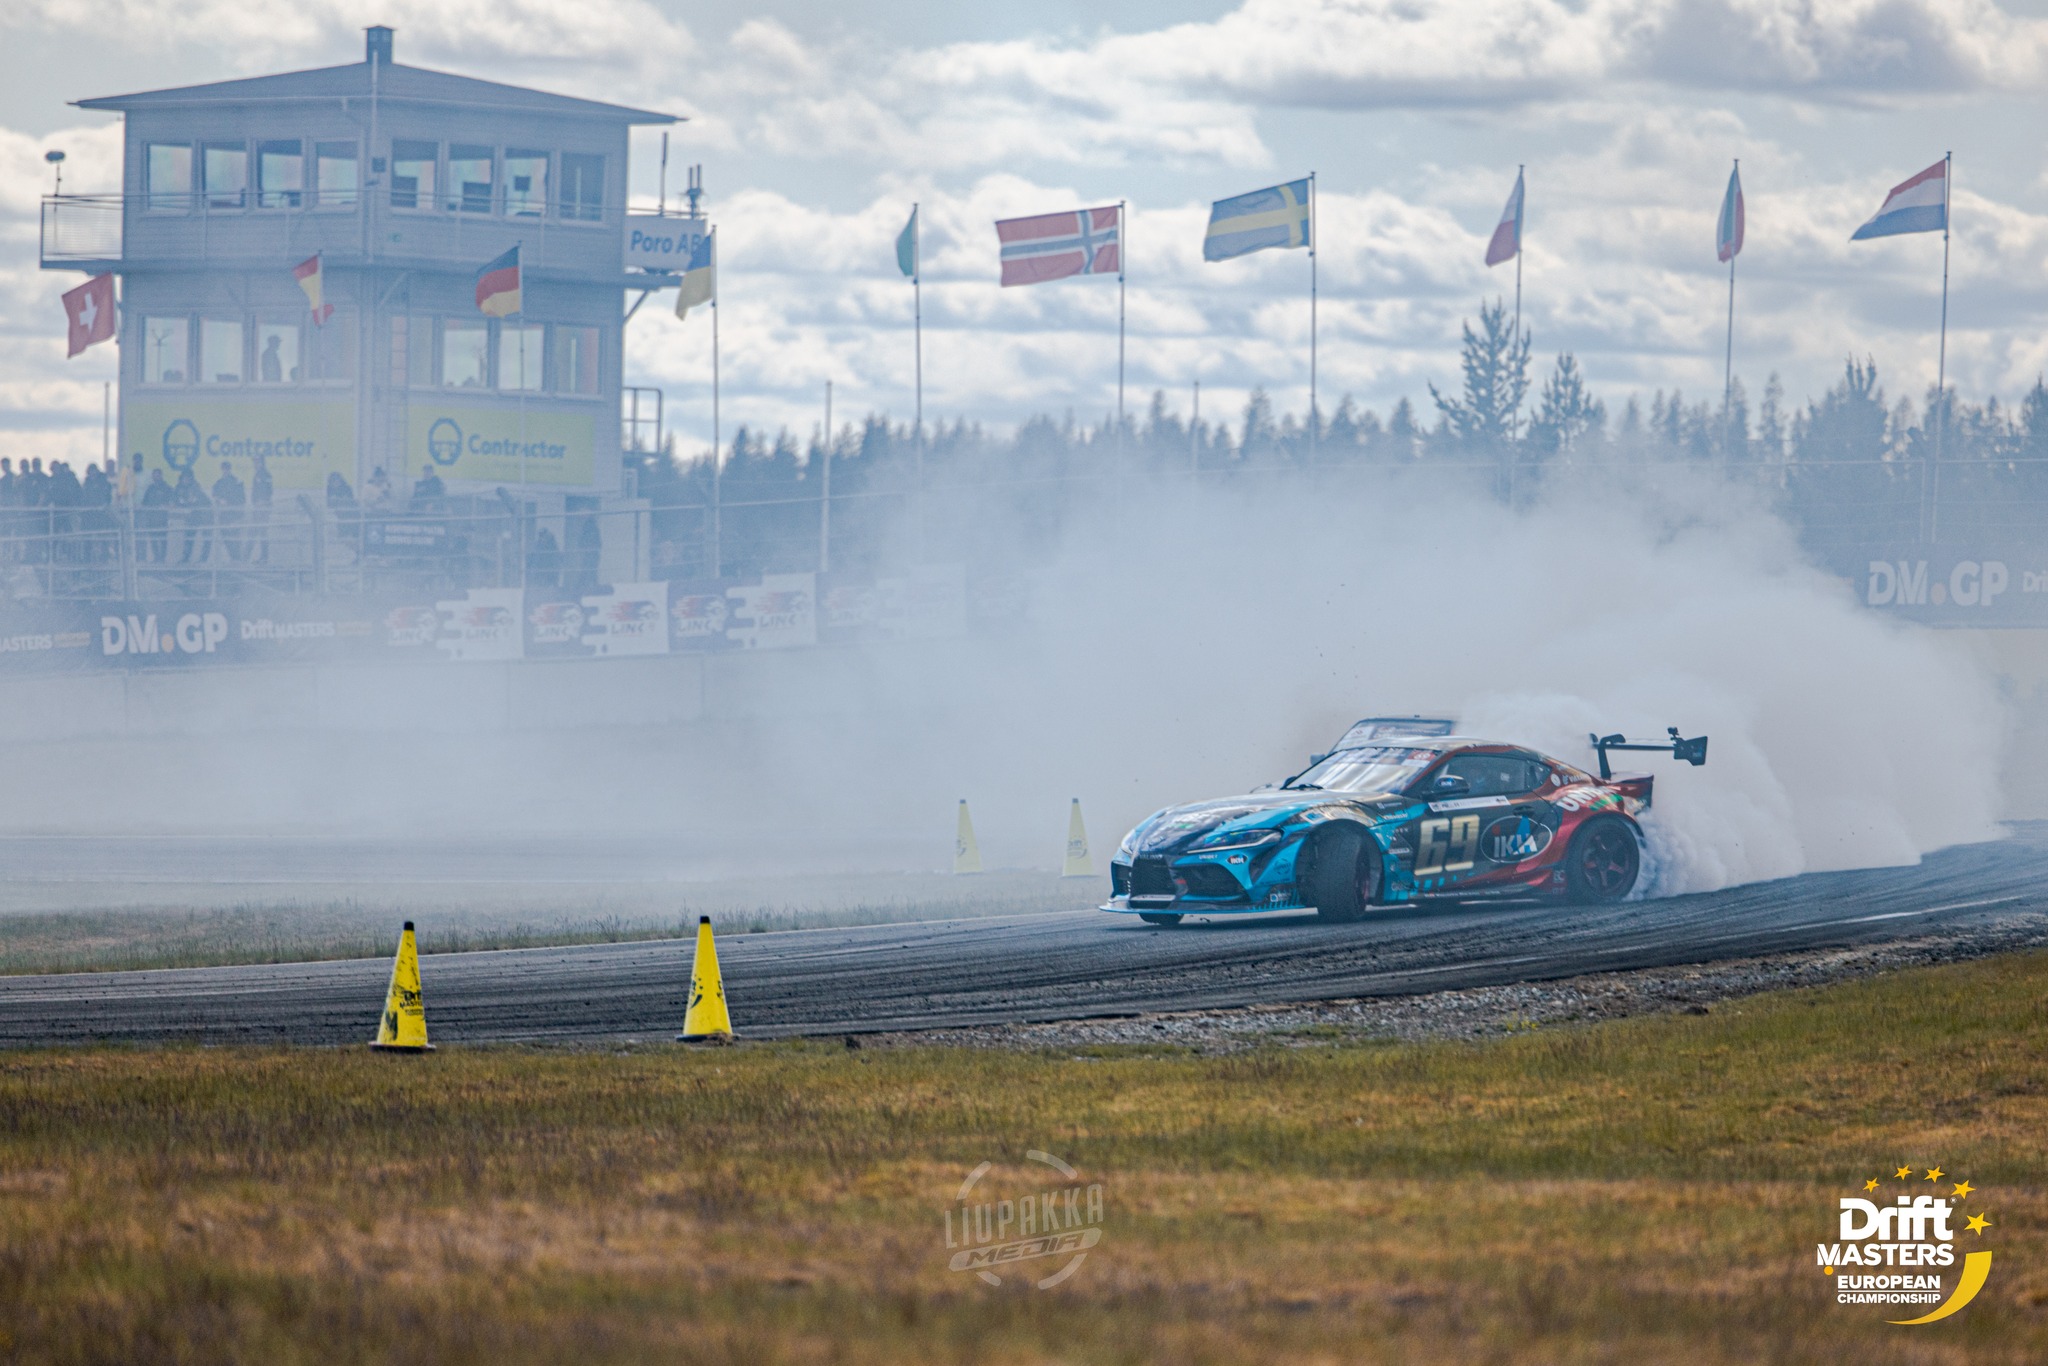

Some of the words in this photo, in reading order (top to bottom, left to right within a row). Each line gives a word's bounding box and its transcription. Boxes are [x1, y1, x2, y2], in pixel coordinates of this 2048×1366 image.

[630, 230, 673, 253] Poro
[206, 434, 313, 457] Contractor
[1868, 560, 2009, 606] DM.GP
[100, 612, 228, 655] DM.GP
[1414, 814, 1480, 876] 69
